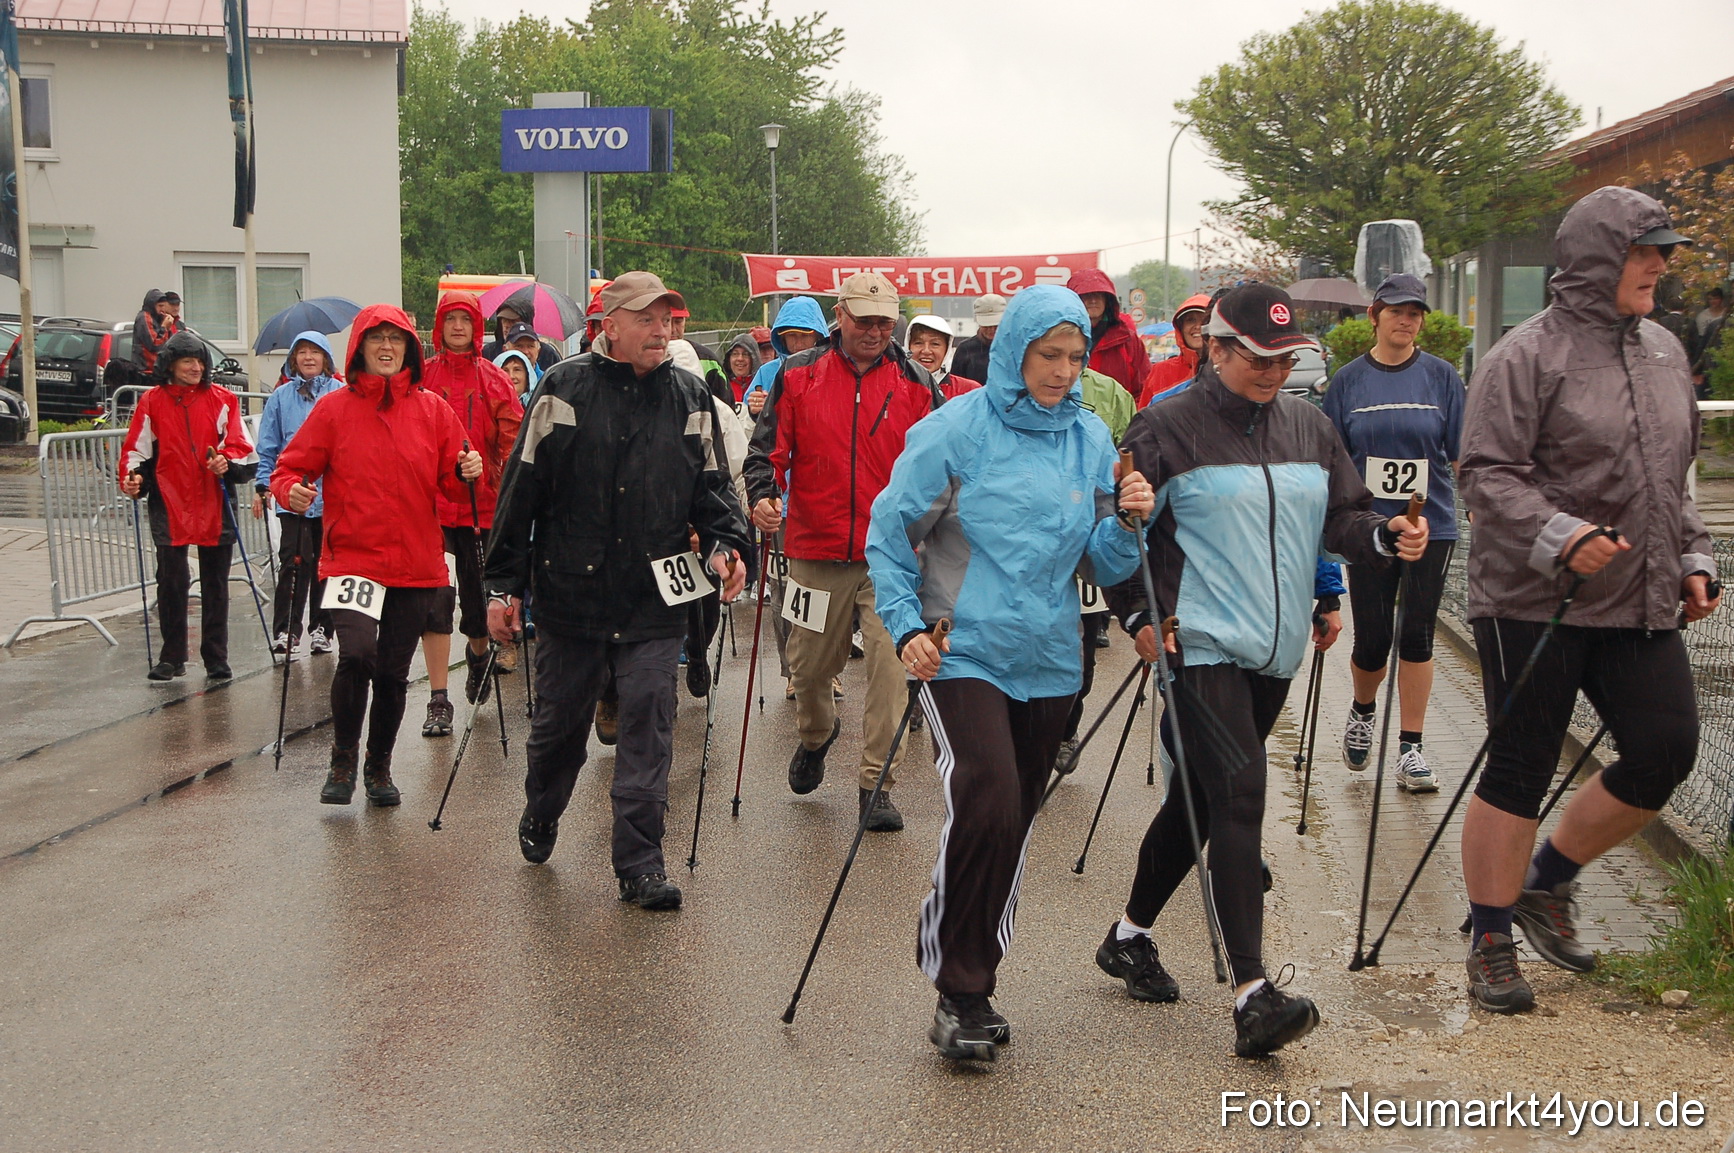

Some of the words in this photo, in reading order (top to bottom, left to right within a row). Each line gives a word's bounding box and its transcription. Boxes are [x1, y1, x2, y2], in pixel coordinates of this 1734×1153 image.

[515, 127, 629, 150] VOLVO
[1382, 461, 1418, 494] 32
[337, 577, 375, 608] 38
[663, 555, 696, 597] 39
[790, 587, 812, 623] 41
